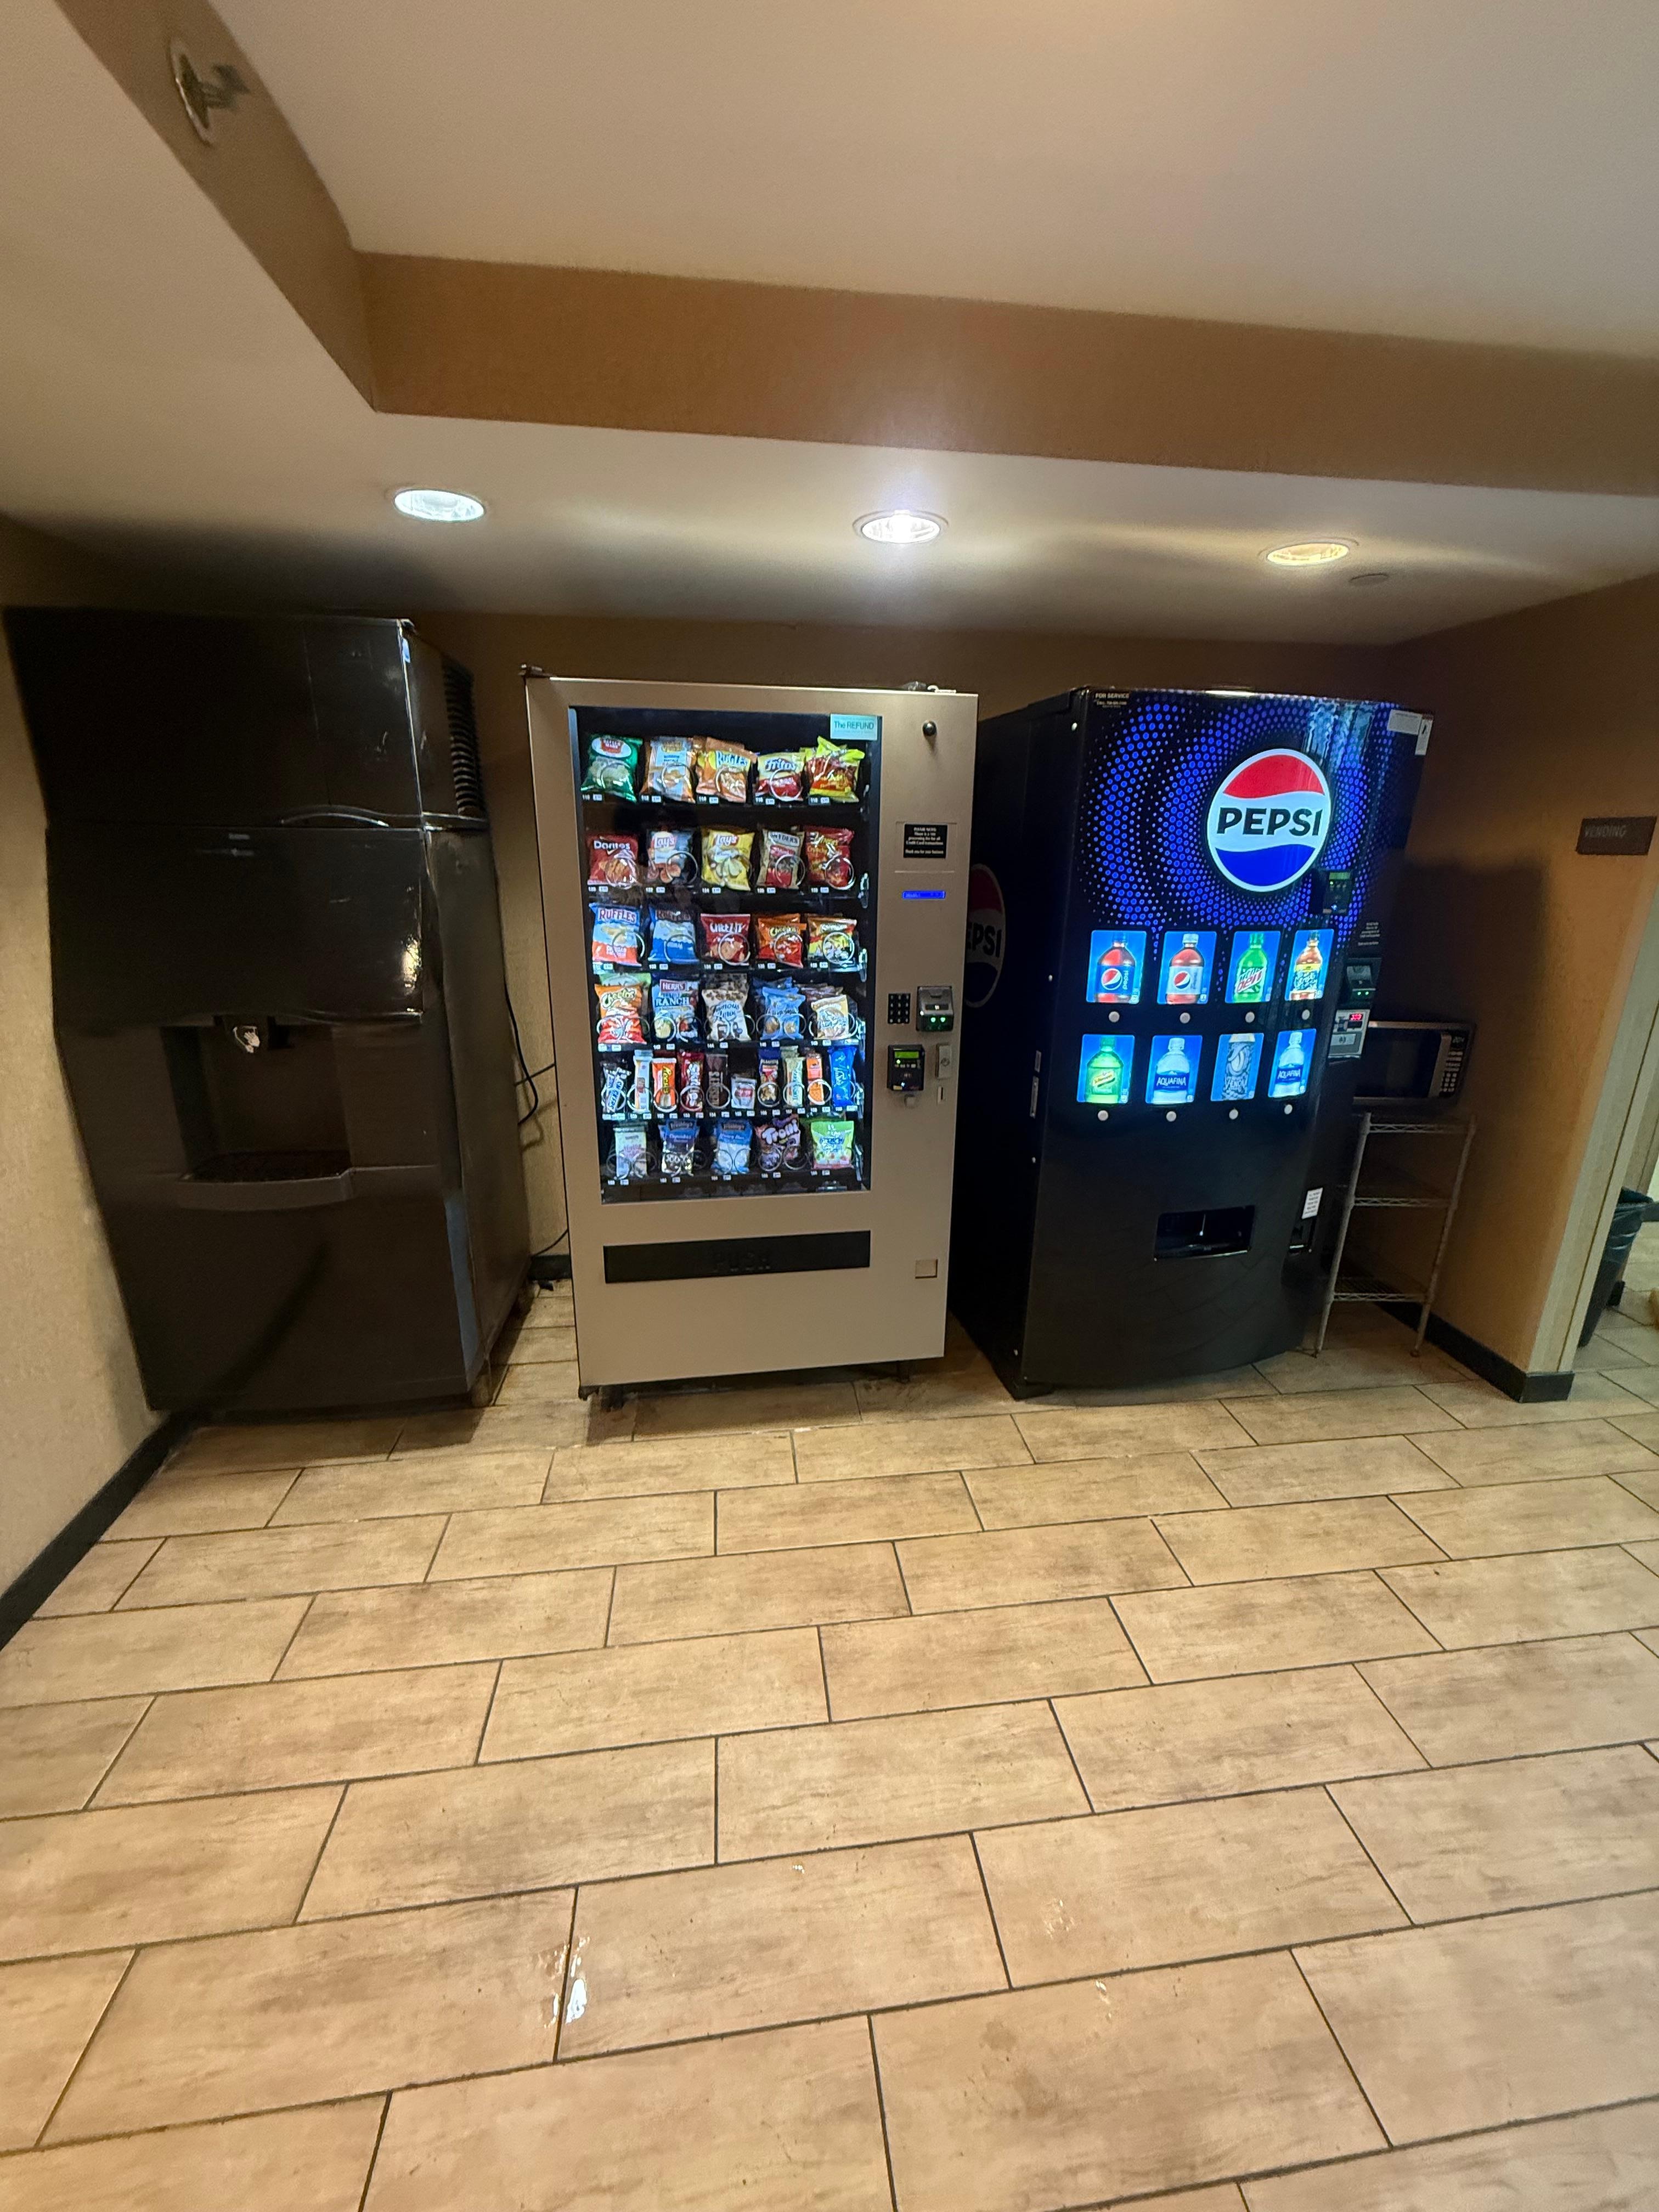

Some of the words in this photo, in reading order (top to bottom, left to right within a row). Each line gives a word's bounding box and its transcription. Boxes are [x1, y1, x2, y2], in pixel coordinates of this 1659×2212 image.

[834, 720, 845, 729] The
[847, 721, 874, 730] REFUND
[1217, 807, 1323, 836] PEPSI
[1585, 825, 1627, 837] VENDING
[594, 840, 630, 850] Doritos
[599, 908, 637, 923] RUFFLES
[662, 982, 685, 990] HERR'S
[601, 988, 637, 1008] Cheetos
[656, 997, 690, 1006] RANCH
[1277, 1069, 1301, 1080] AQUAFINA
[1156, 1076, 1187, 1087] AQUAFINA
[761, 1119, 799, 1145] Trolli
